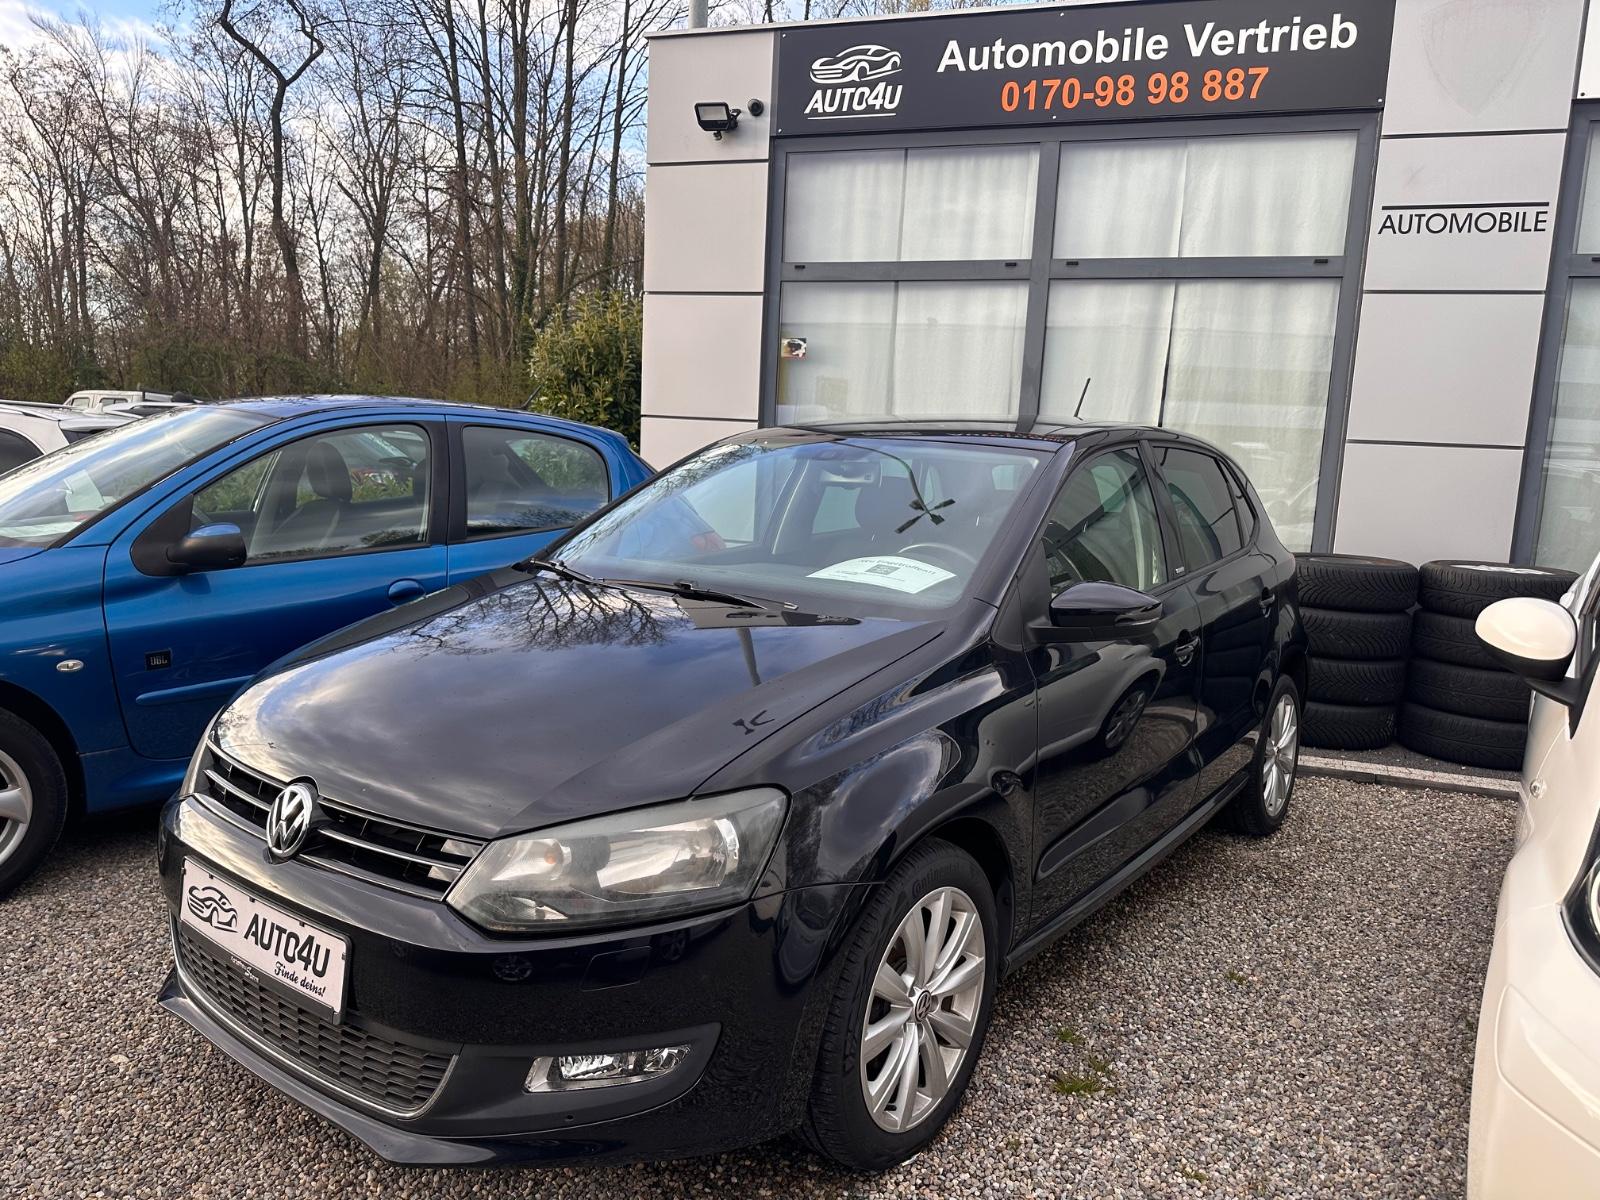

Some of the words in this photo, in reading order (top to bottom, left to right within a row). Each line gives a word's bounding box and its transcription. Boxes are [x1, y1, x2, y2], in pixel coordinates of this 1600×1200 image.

[936, 27, 1169, 73] Automobile
[1183, 13, 1358, 57] Vertrieb
[803, 81, 903, 114] AUTO4U
[1000, 74, 1136, 112] 0170-98
[1147, 71, 1190, 105] 98
[1201, 66, 1269, 102] 887
[1378, 210, 1548, 235] AUTOMOBILE
[243, 912, 331, 978] AUTO4U
[274, 960, 299, 984] Finde
[299, 976, 327, 997] deins!
